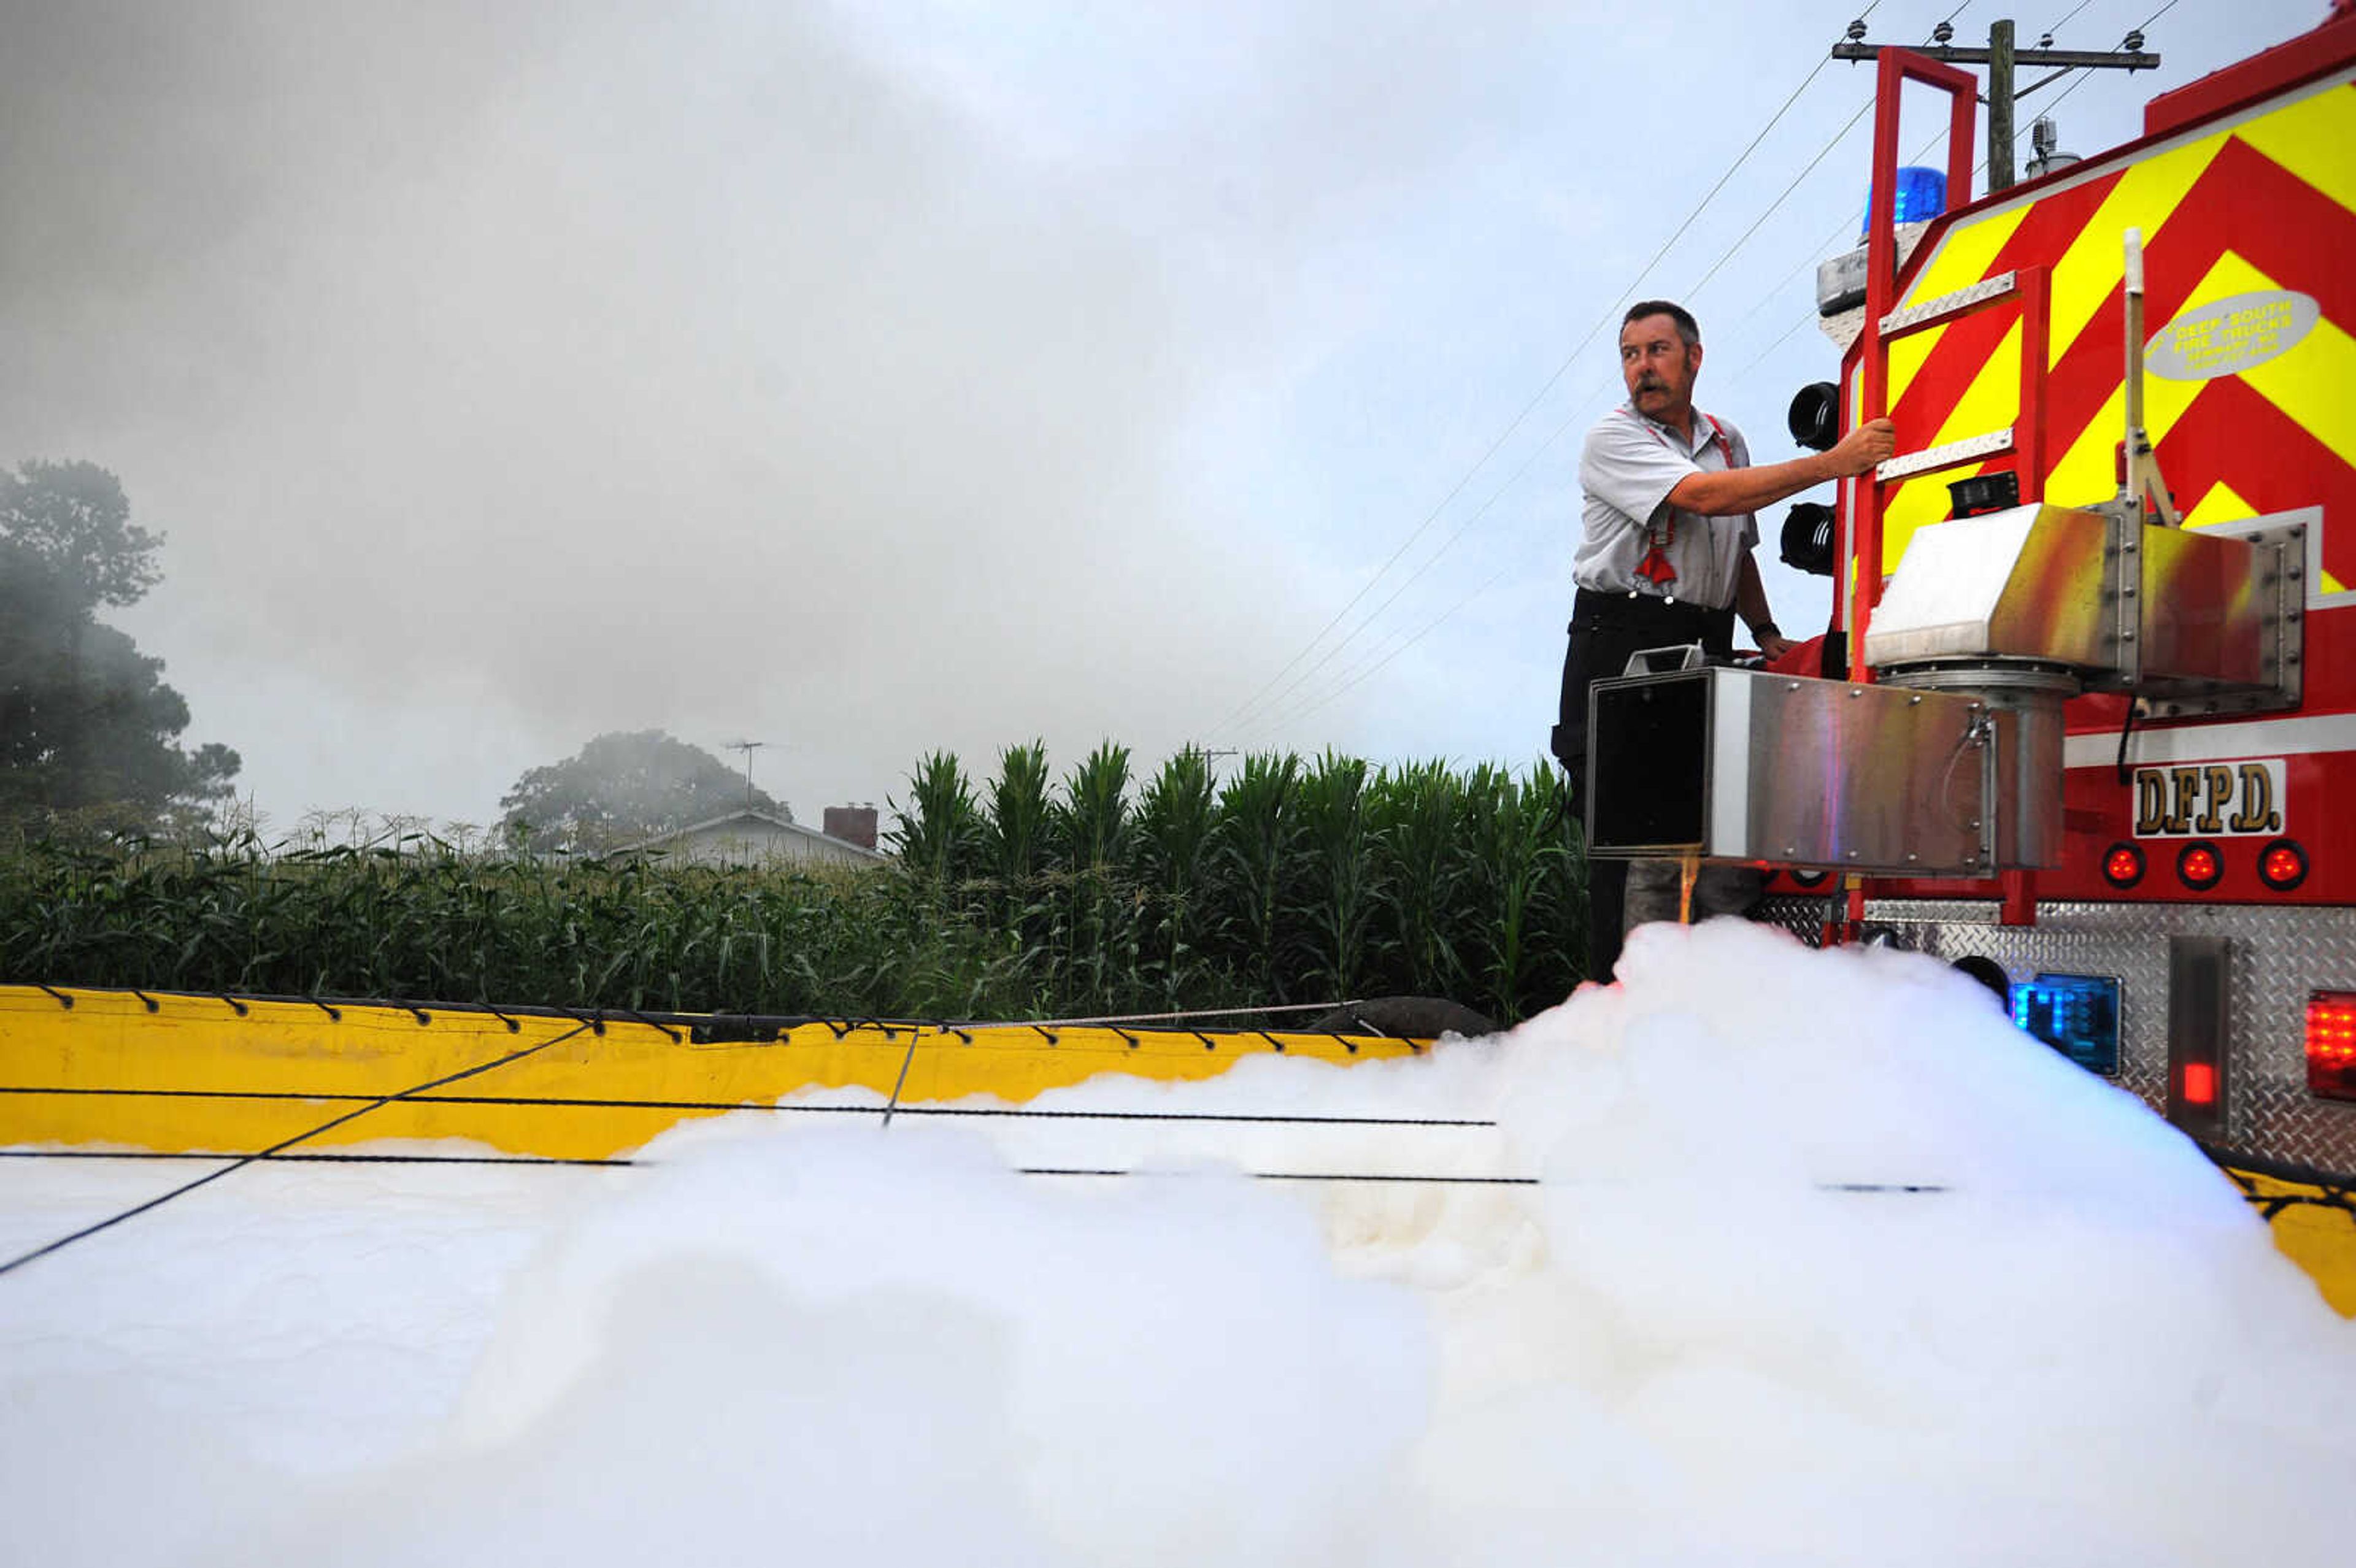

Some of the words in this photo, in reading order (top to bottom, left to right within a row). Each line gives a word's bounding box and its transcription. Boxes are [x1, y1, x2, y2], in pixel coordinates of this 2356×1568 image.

[2173, 334, 2212, 353] FIRE
[2221, 314, 2292, 341] TRUCKS
[2176, 318, 2222, 339] DEEP
[2230, 299, 2292, 326] SOUTH
[2136, 764, 2281, 835] D.F.P.D.
